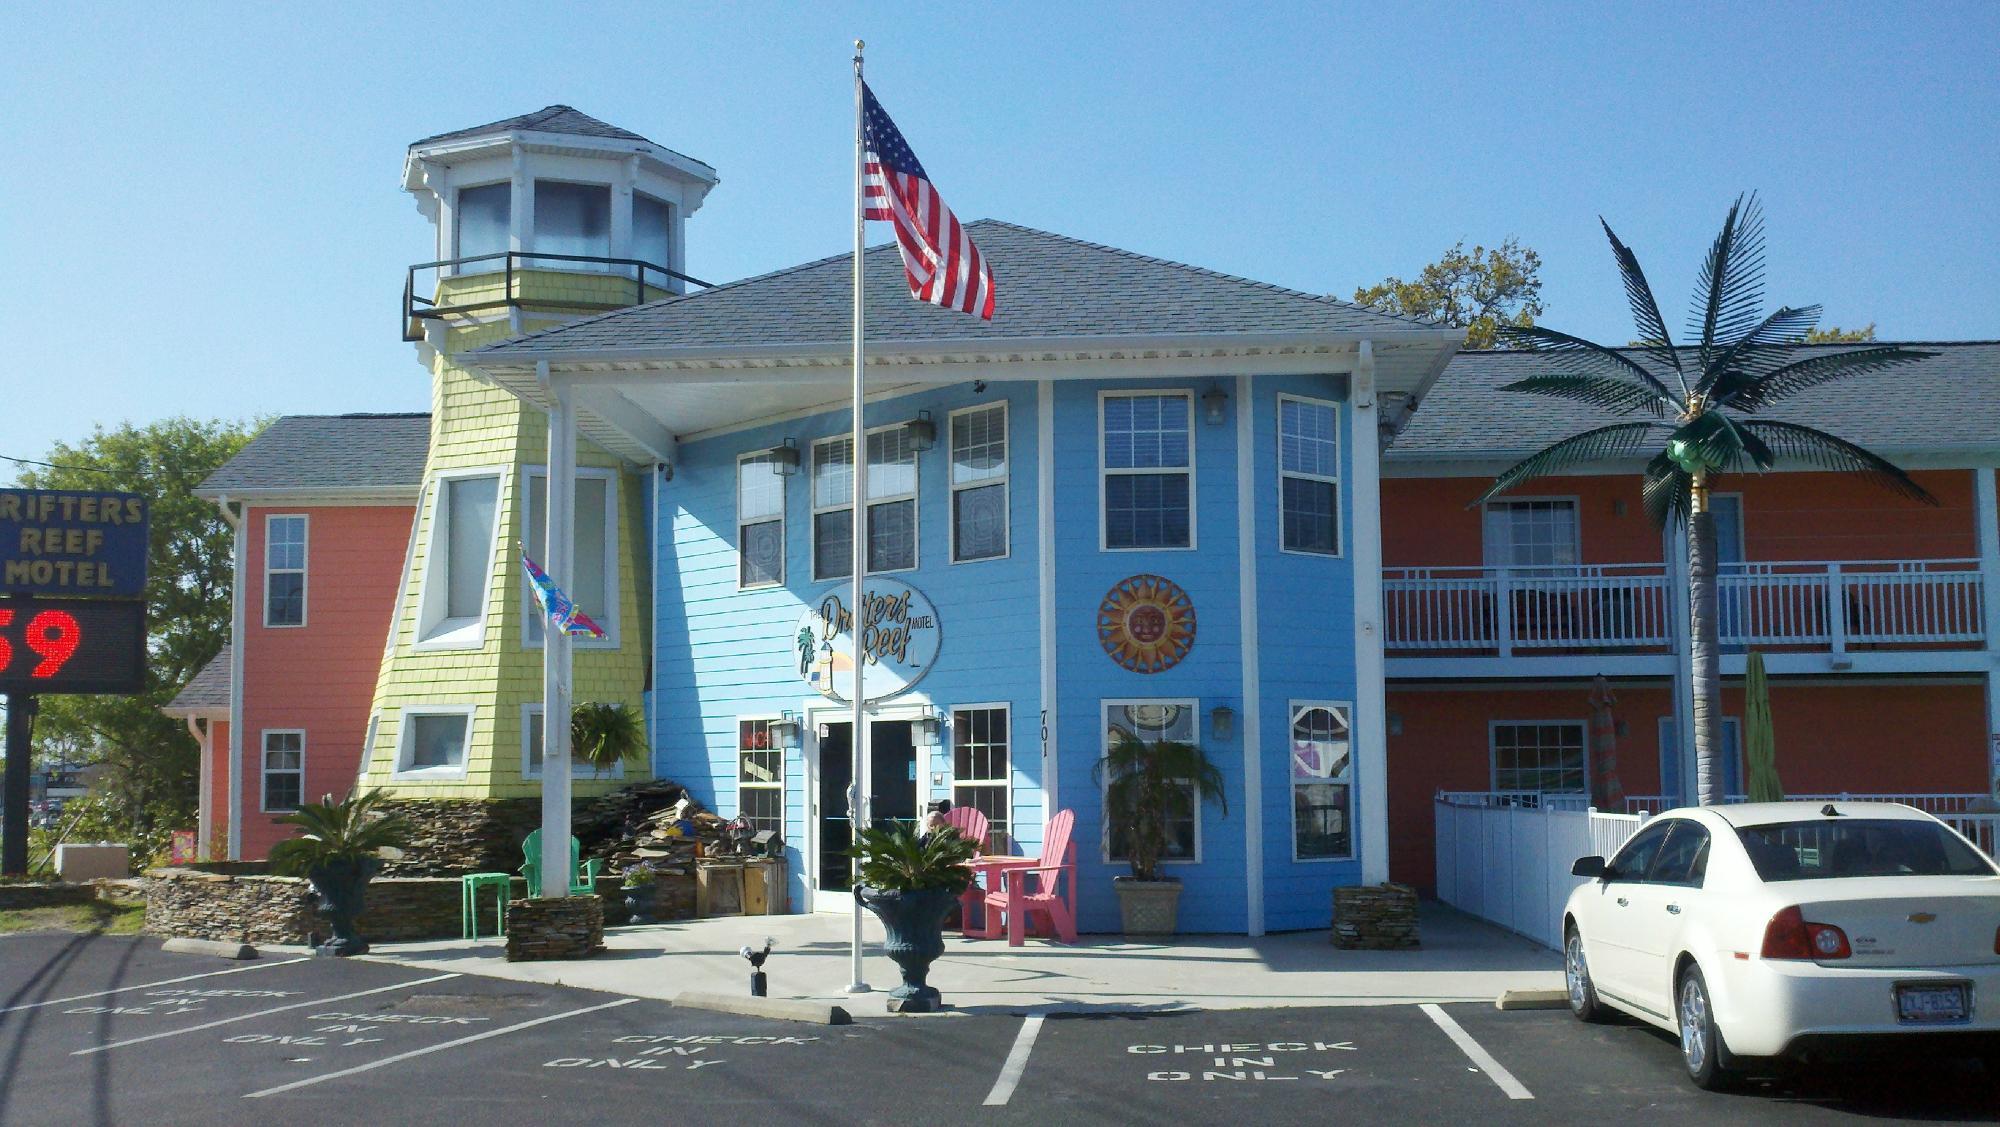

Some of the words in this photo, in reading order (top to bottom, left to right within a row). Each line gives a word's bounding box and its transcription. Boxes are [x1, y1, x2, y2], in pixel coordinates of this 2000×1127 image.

[20, 527, 104, 556] REEF
[5, 559, 114, 587] MOTEL
[821, 590, 913, 641] Drters
[912, 615, 934, 629] MOTEL
[862, 617, 912, 665] Reef
[145, 990, 304, 998] CHECK
[63, 1007, 203, 1015] ONLY
[307, 1012, 490, 1025] CHECK
[314, 1025, 379, 1034] IN
[222, 1034, 384, 1047] ONLY
[611, 1035, 821, 1045] CHECK
[638, 1046, 708, 1056] IN
[1127, 1041, 1358, 1054] CHECK
[542, 1058, 728, 1070] ONLY
[1214, 1056, 1275, 1067] IN
[1147, 1068, 1353, 1081] ONLY
